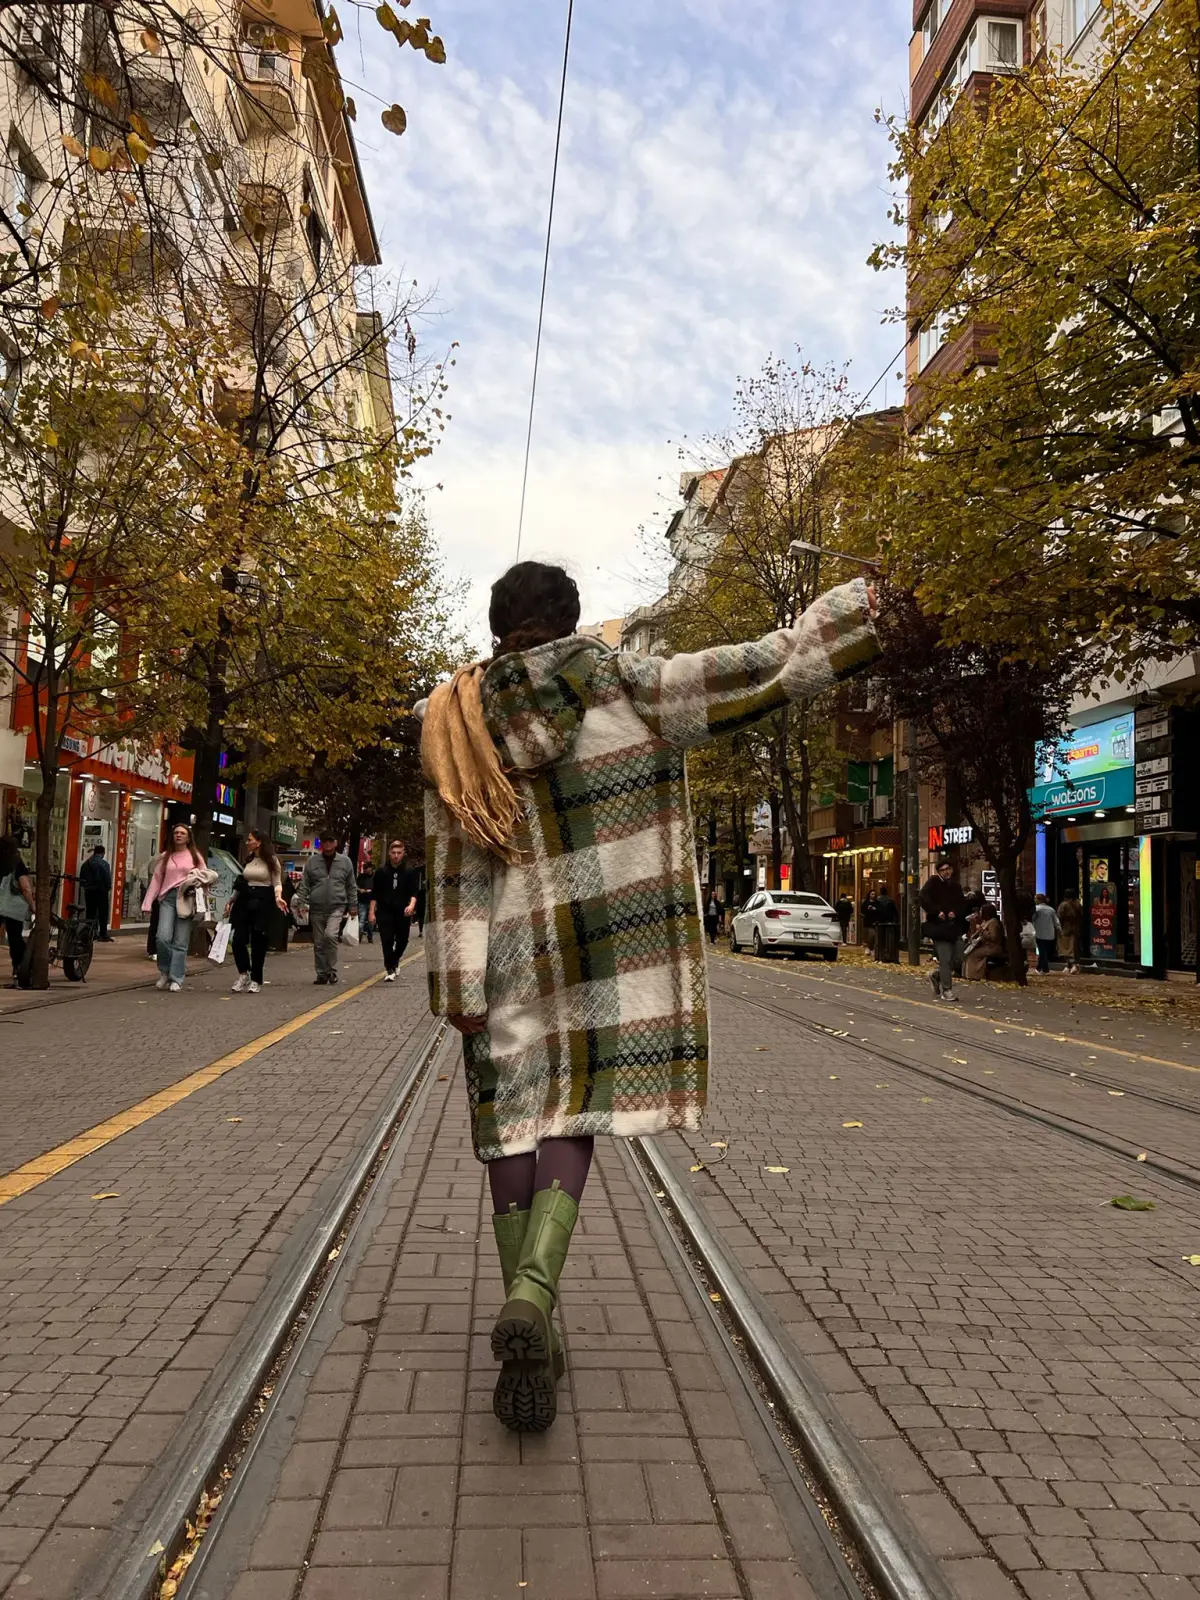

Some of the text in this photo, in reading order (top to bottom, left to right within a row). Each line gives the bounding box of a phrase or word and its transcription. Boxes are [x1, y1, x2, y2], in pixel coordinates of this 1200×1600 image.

[1052, 786, 1096, 806] watsons
[929, 825, 974, 850] IN STREET
